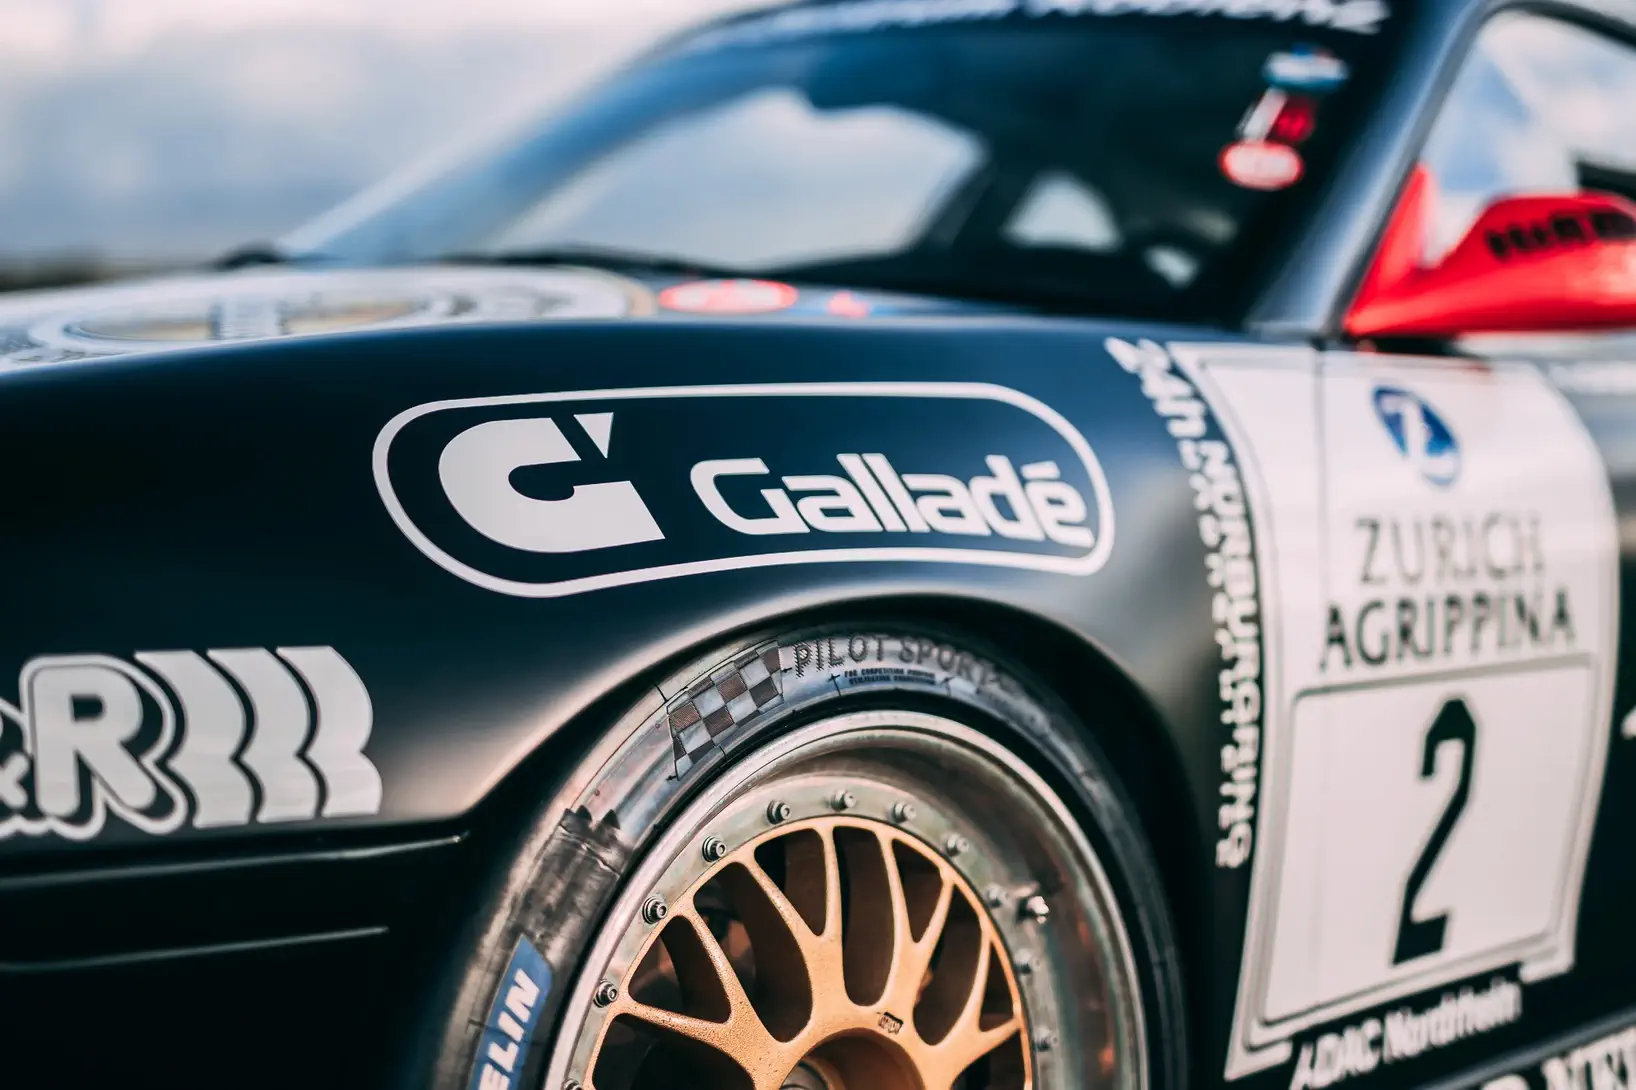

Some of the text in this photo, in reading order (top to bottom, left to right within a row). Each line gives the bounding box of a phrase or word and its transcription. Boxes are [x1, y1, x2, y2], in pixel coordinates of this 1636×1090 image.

[690, 453, 1095, 547] Galladé
[1355, 510, 1546, 587] ZURICH
[793, 634, 996, 686] PILOT SPORT
[1319, 587, 1577, 672] AGRIPPINA
[1393, 699, 1476, 966] 2
[1290, 1018, 1381, 1090] ADAC
